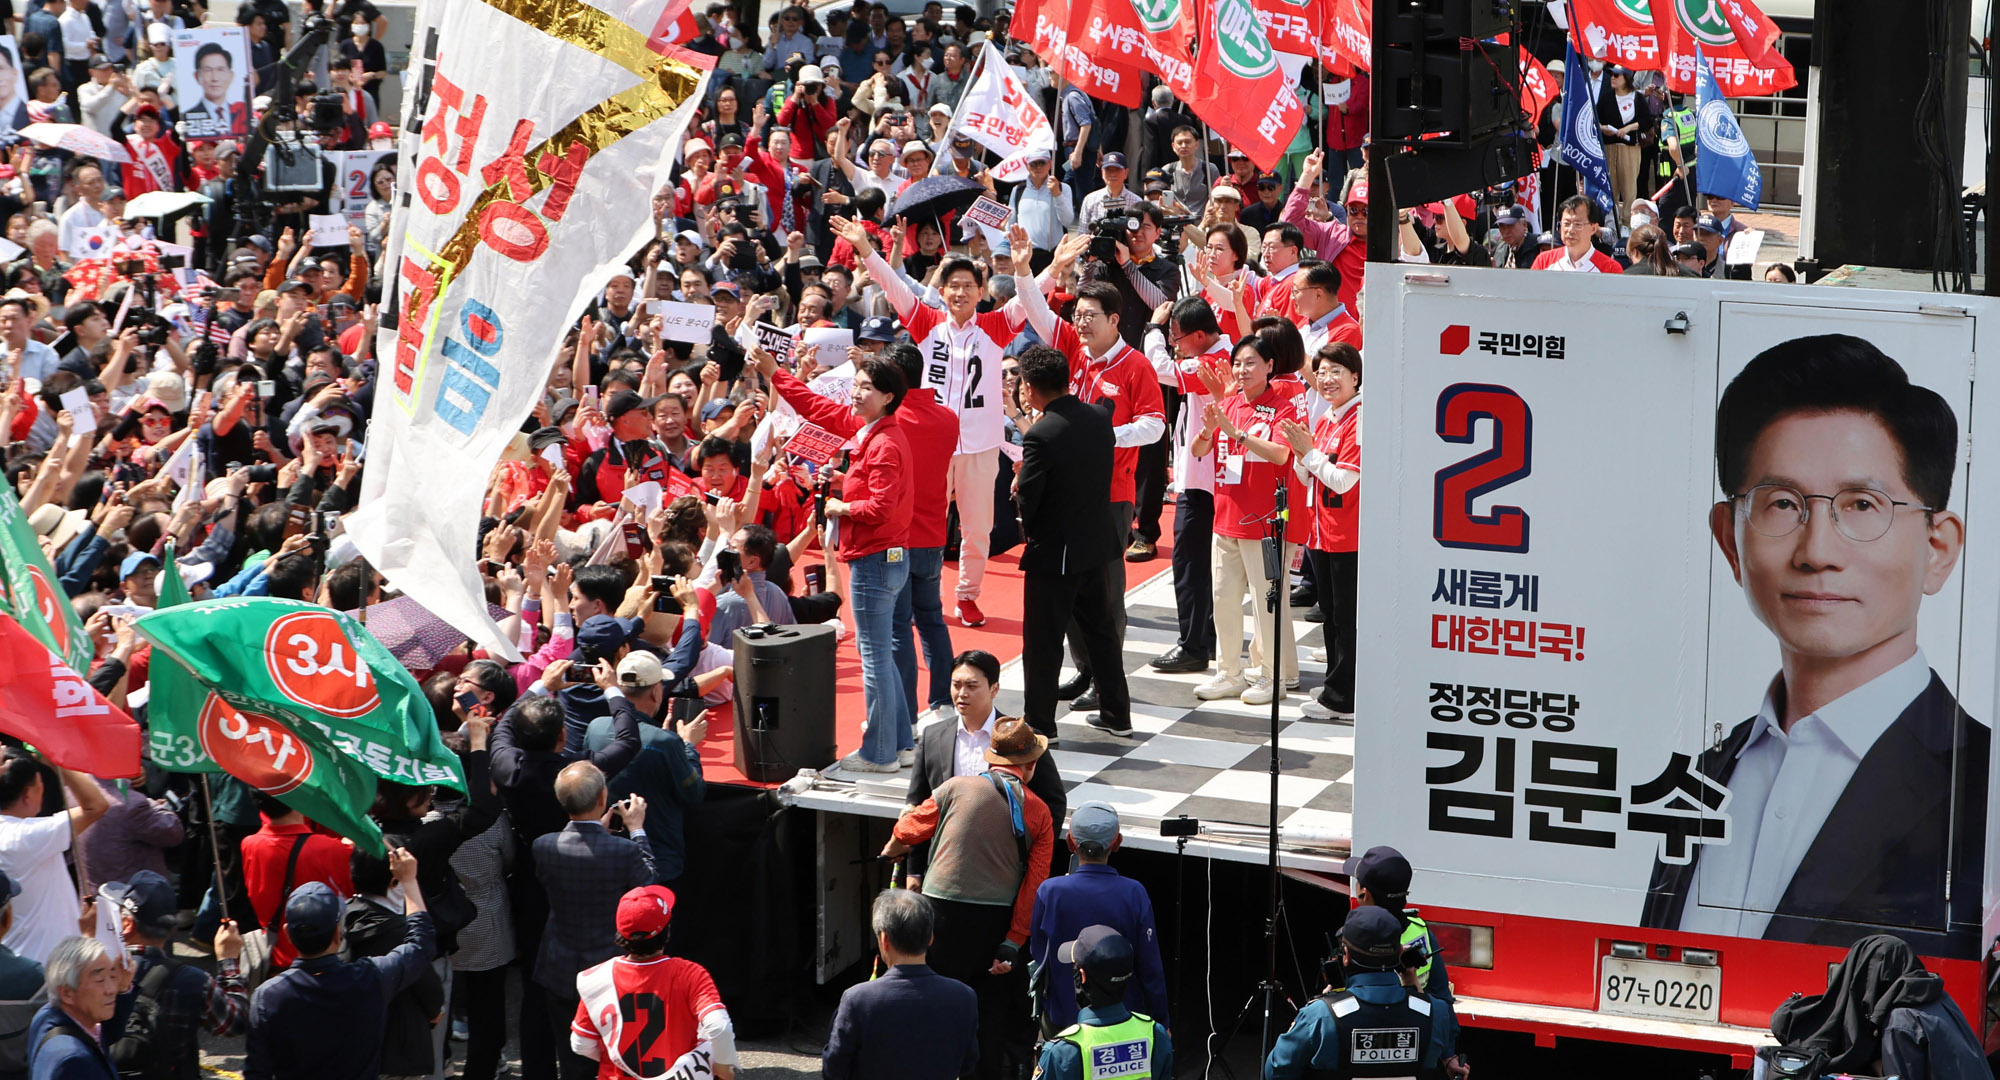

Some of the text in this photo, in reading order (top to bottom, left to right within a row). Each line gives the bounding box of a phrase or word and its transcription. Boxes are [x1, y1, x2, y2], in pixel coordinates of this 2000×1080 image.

[1563, 143, 1592, 169] ROTC
[348, 170, 368, 199] 2
[1478, 331, 1566, 360] 국민의힘
[964, 355, 985, 409] 2
[1432, 381, 1533, 554] 2
[1431, 568, 1539, 612] 새롭게
[1431, 613, 1586, 662] 대한민국!
[1429, 682, 1580, 733] 정정당당
[1425, 731, 1726, 859] 김문수
[1607, 975, 1713, 1011] 87누0220
[619, 992, 667, 1078] 2
[1360, 1049, 1410, 1060] POLICE
[1099, 1061, 1144, 1076] POLICE
